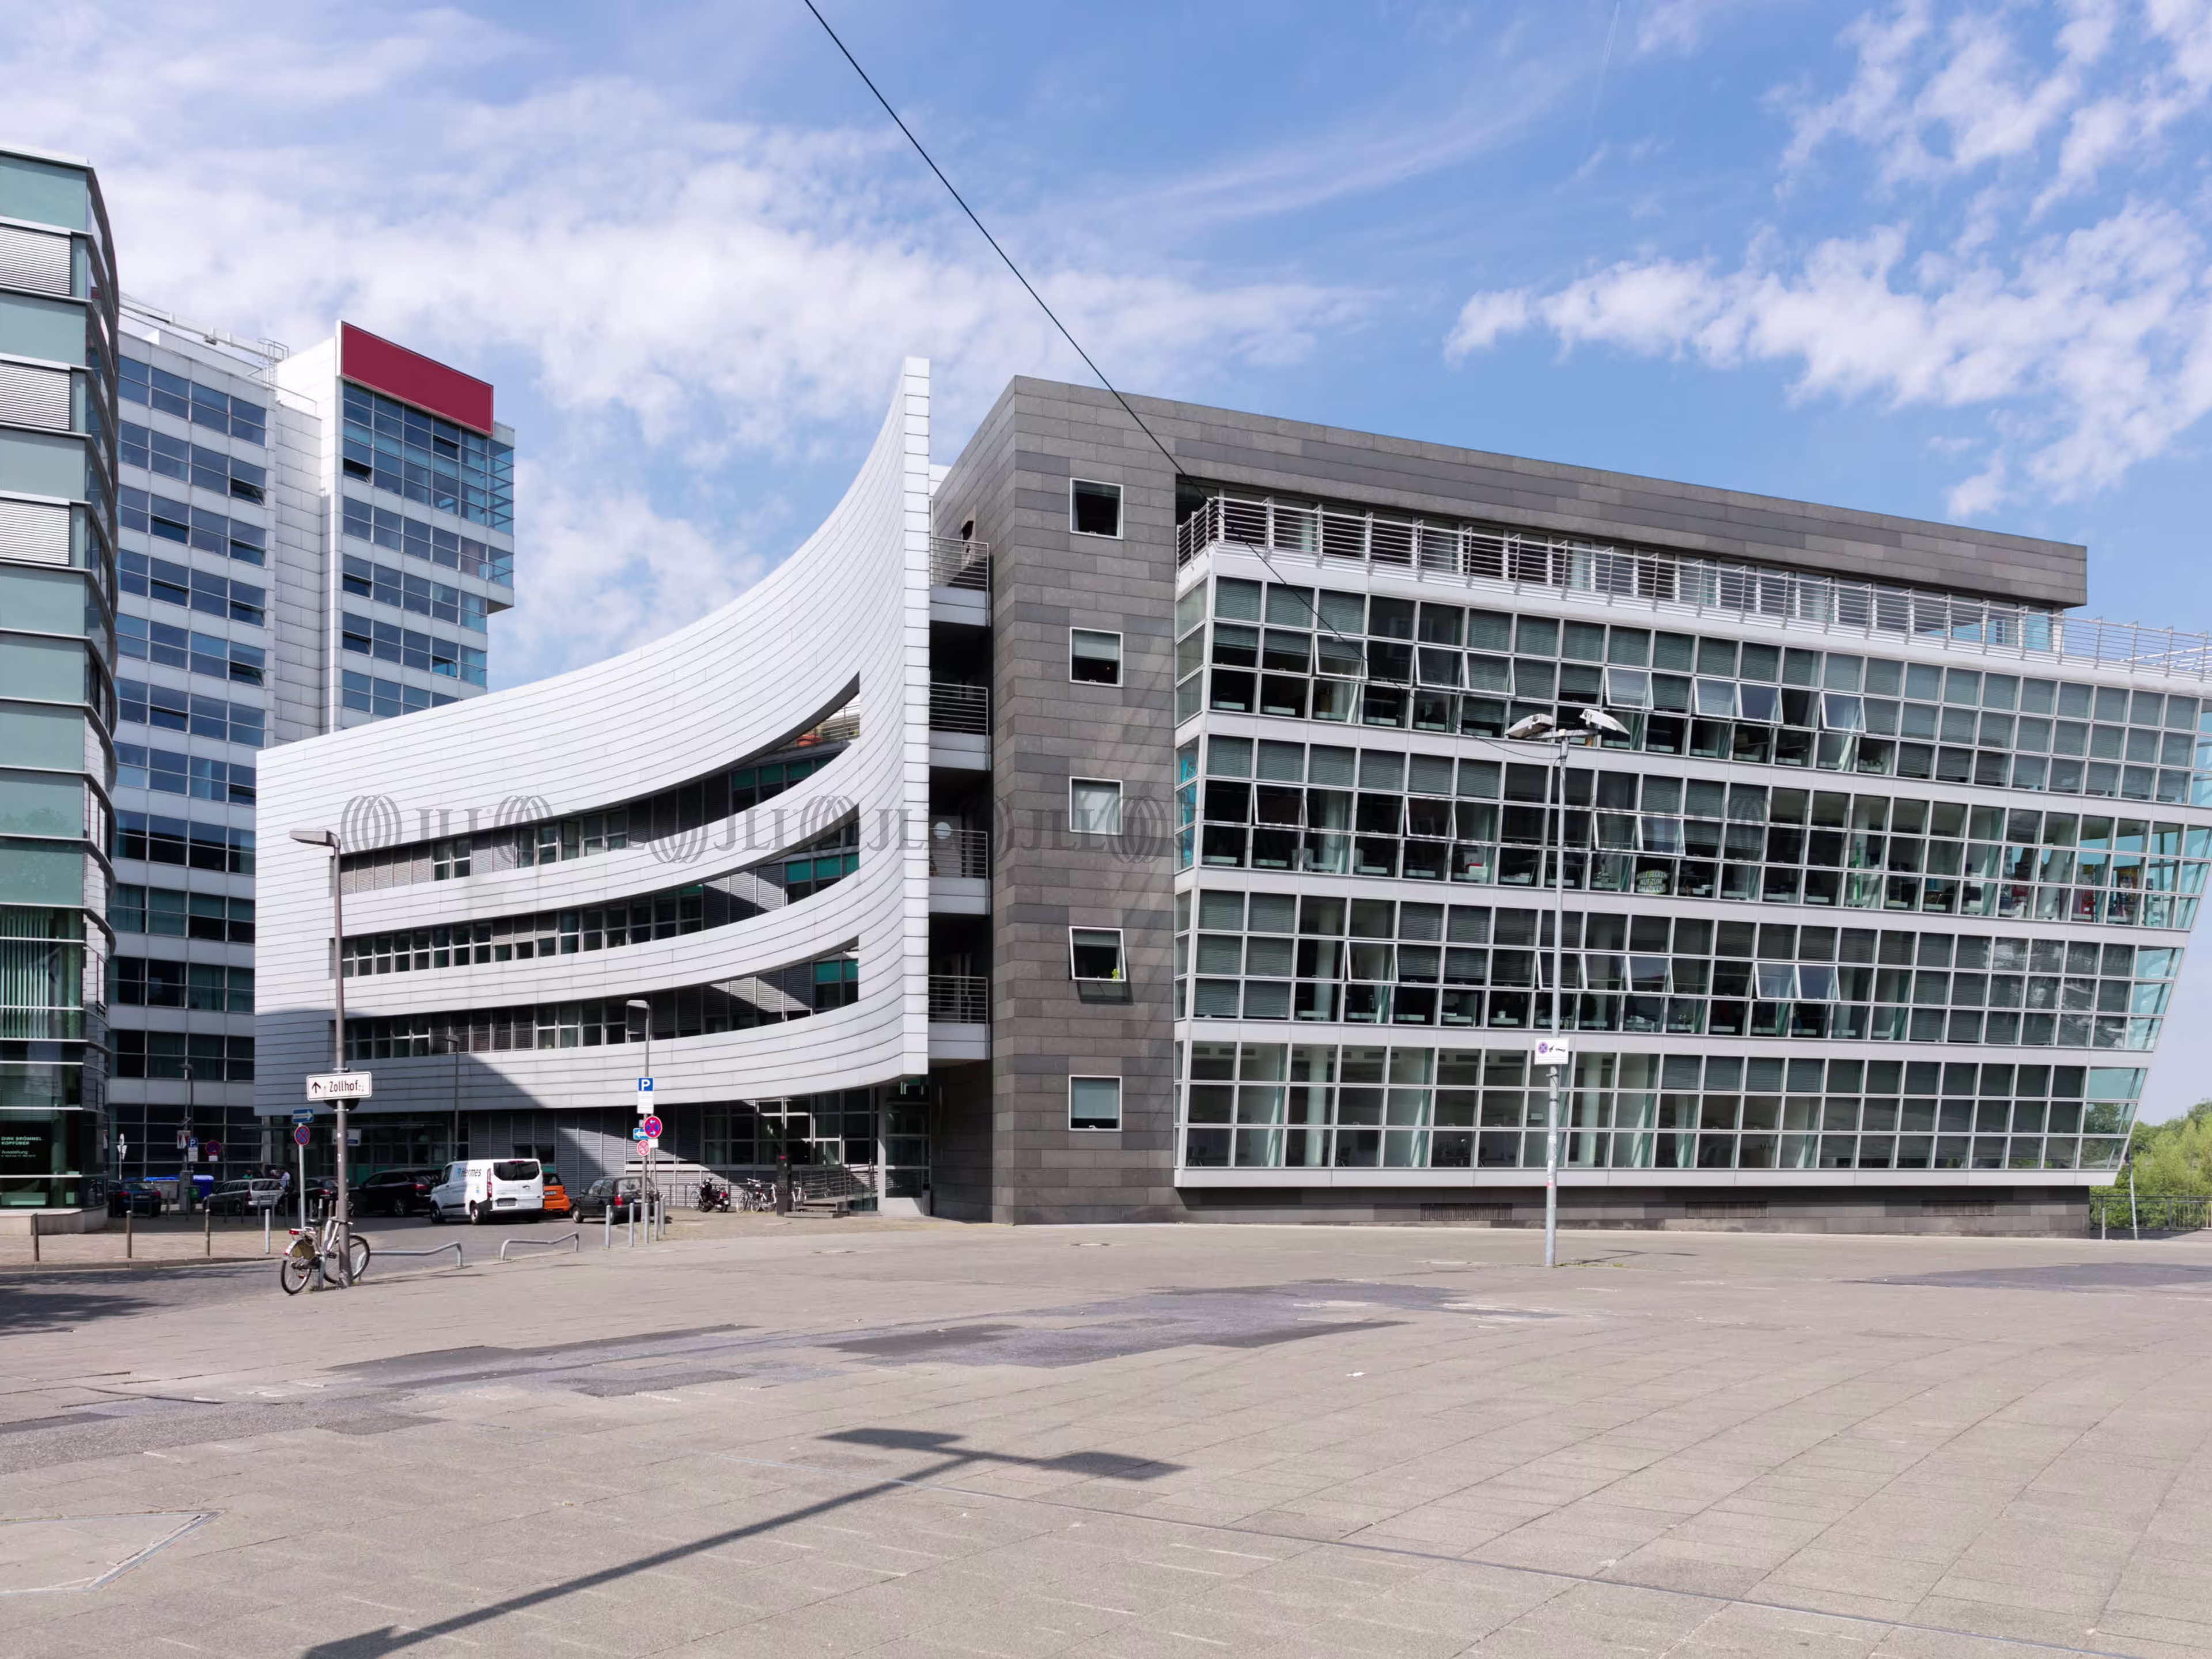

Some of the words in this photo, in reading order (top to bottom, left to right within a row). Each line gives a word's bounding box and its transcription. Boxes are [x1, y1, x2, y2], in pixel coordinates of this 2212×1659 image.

[329, 1080, 358, 1092] Zollhof
[642, 1079, 650, 1091] P
[190, 1139, 196, 1147] P
[461, 1168, 482, 1177] Hermes
